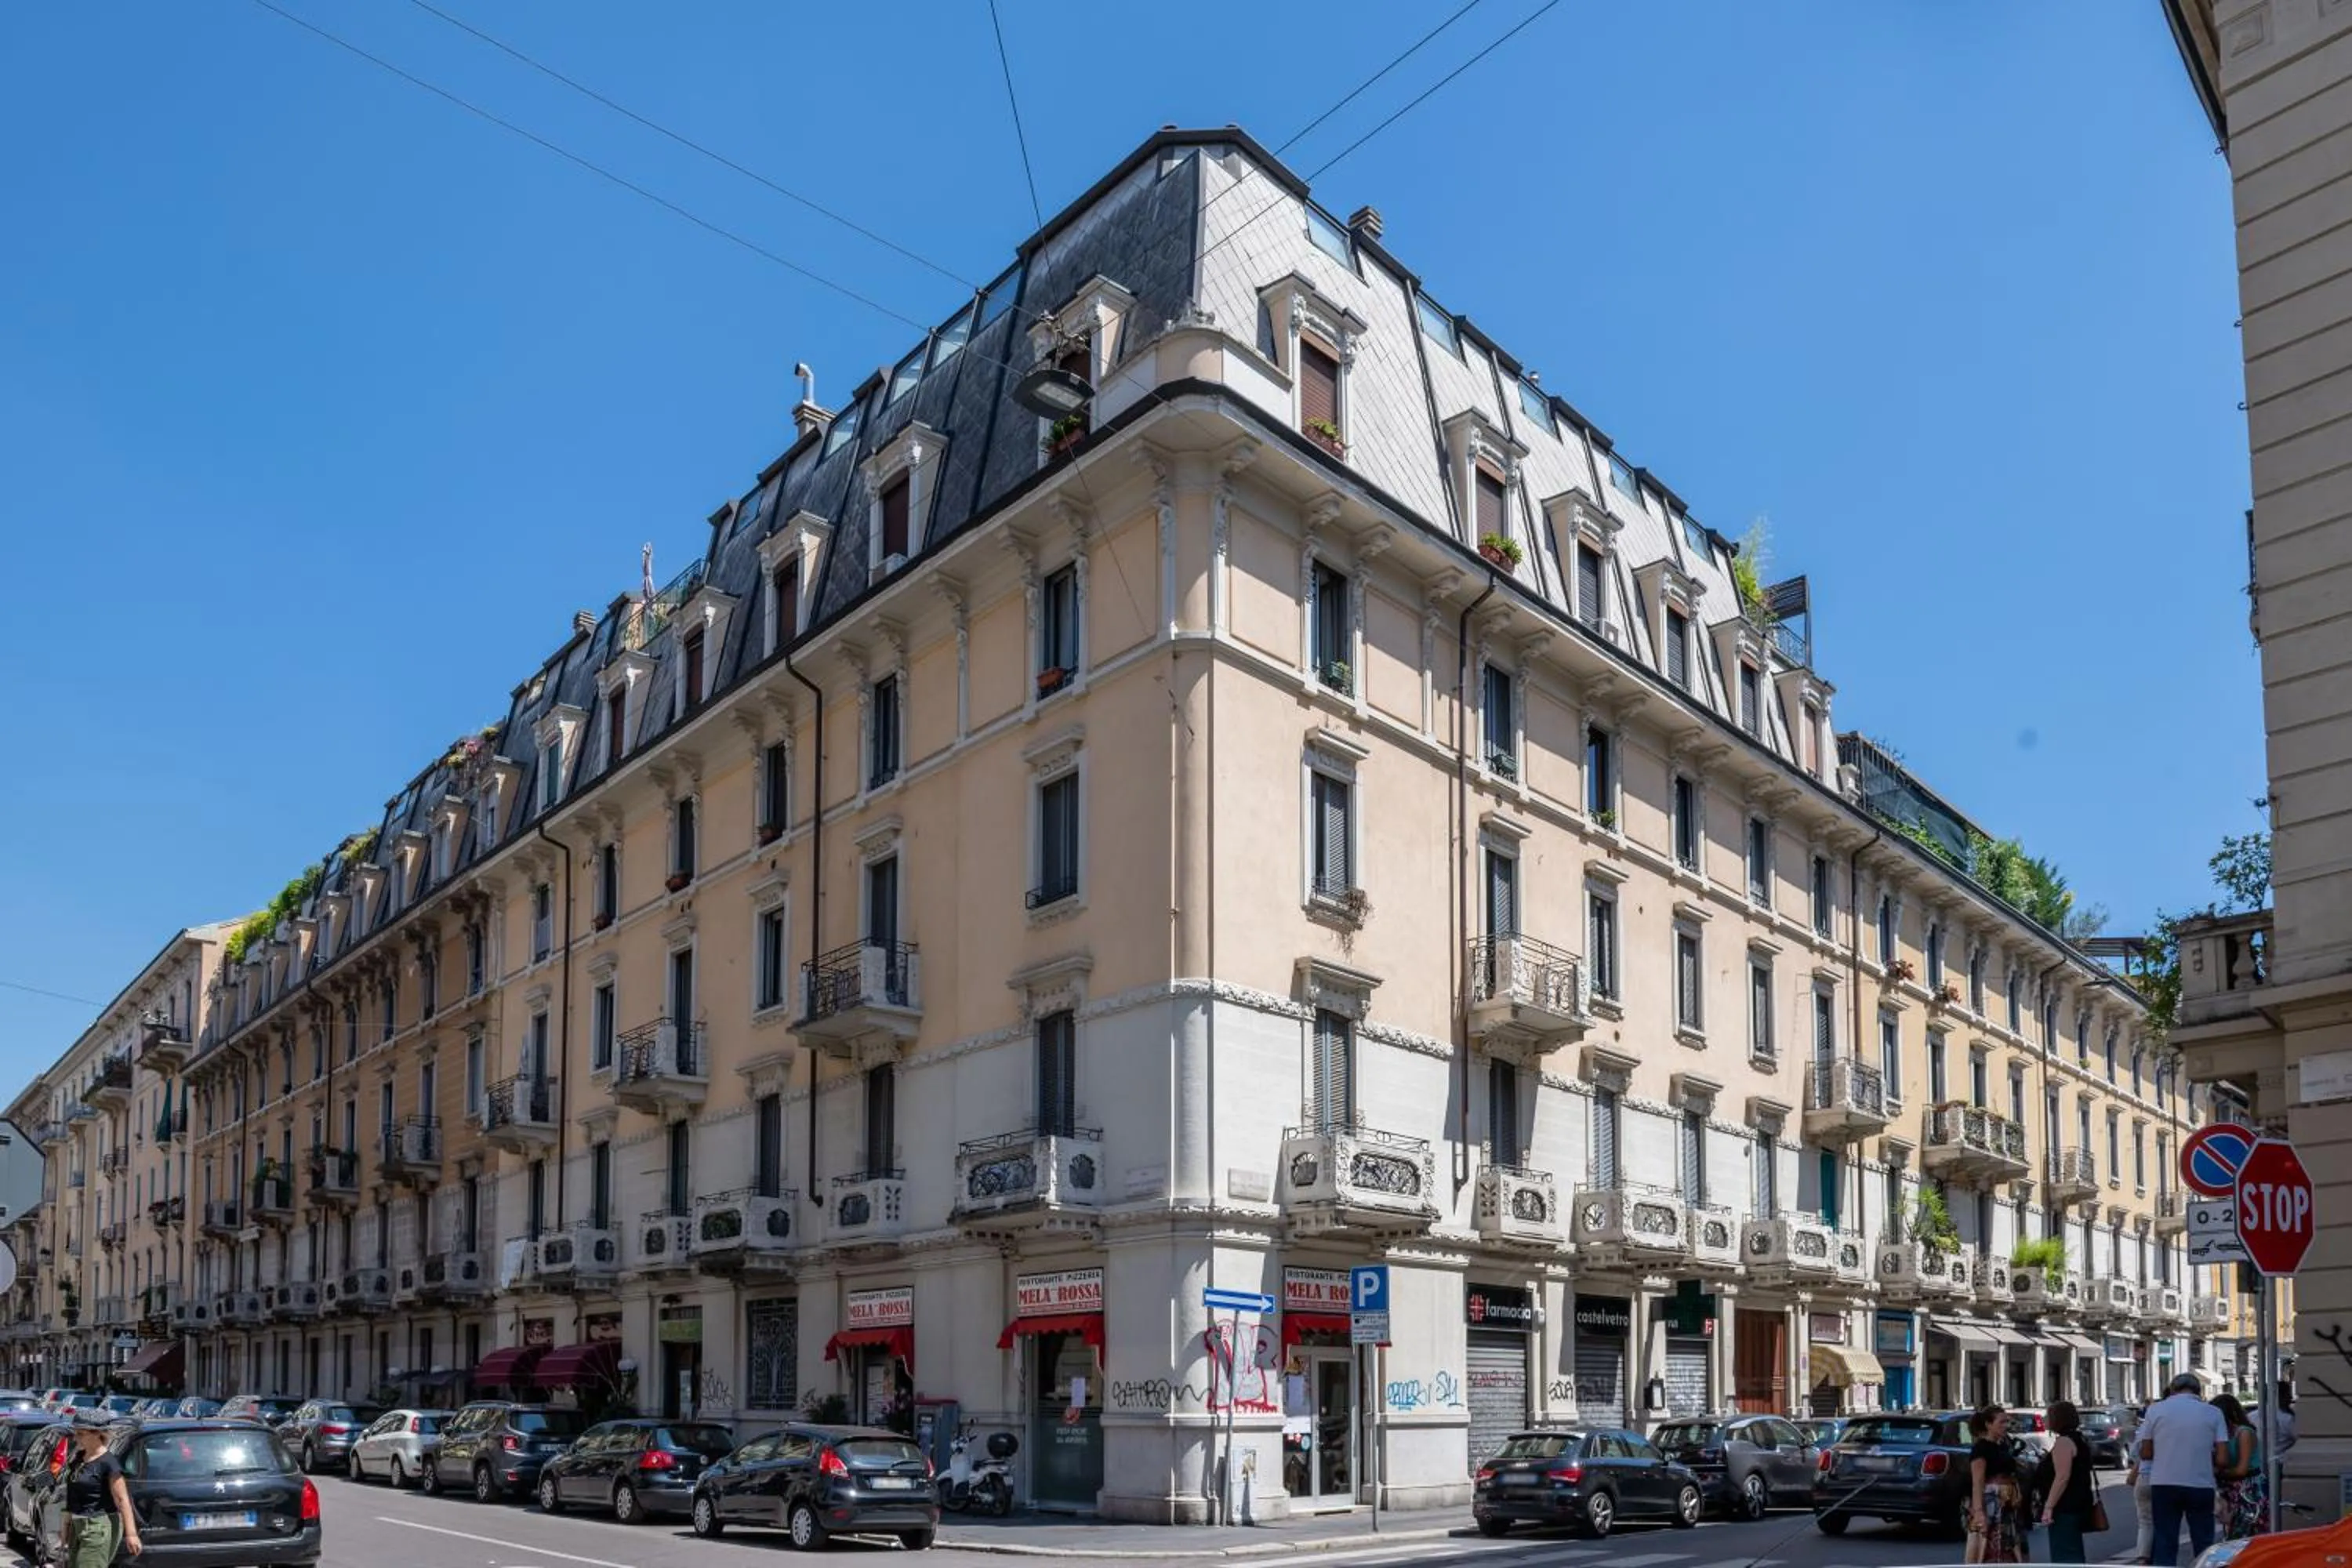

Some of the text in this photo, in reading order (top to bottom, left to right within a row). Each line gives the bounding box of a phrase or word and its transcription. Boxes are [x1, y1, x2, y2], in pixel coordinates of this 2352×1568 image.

[2242, 1182, 2309, 1233] STOP
[1019, 1275, 1063, 1286] RISTORANTE
[1287, 1270, 1332, 1281] RISTORANTE
[1019, 1283, 1100, 1305] MELA ROSSA
[1287, 1282, 1348, 1301] MELA RO
[1358, 1271, 1380, 1307] P
[879, 1299, 910, 1316] ROSSA
[1486, 1298, 1531, 1319] farmacia
[1577, 1308, 1630, 1327] castelvetro
